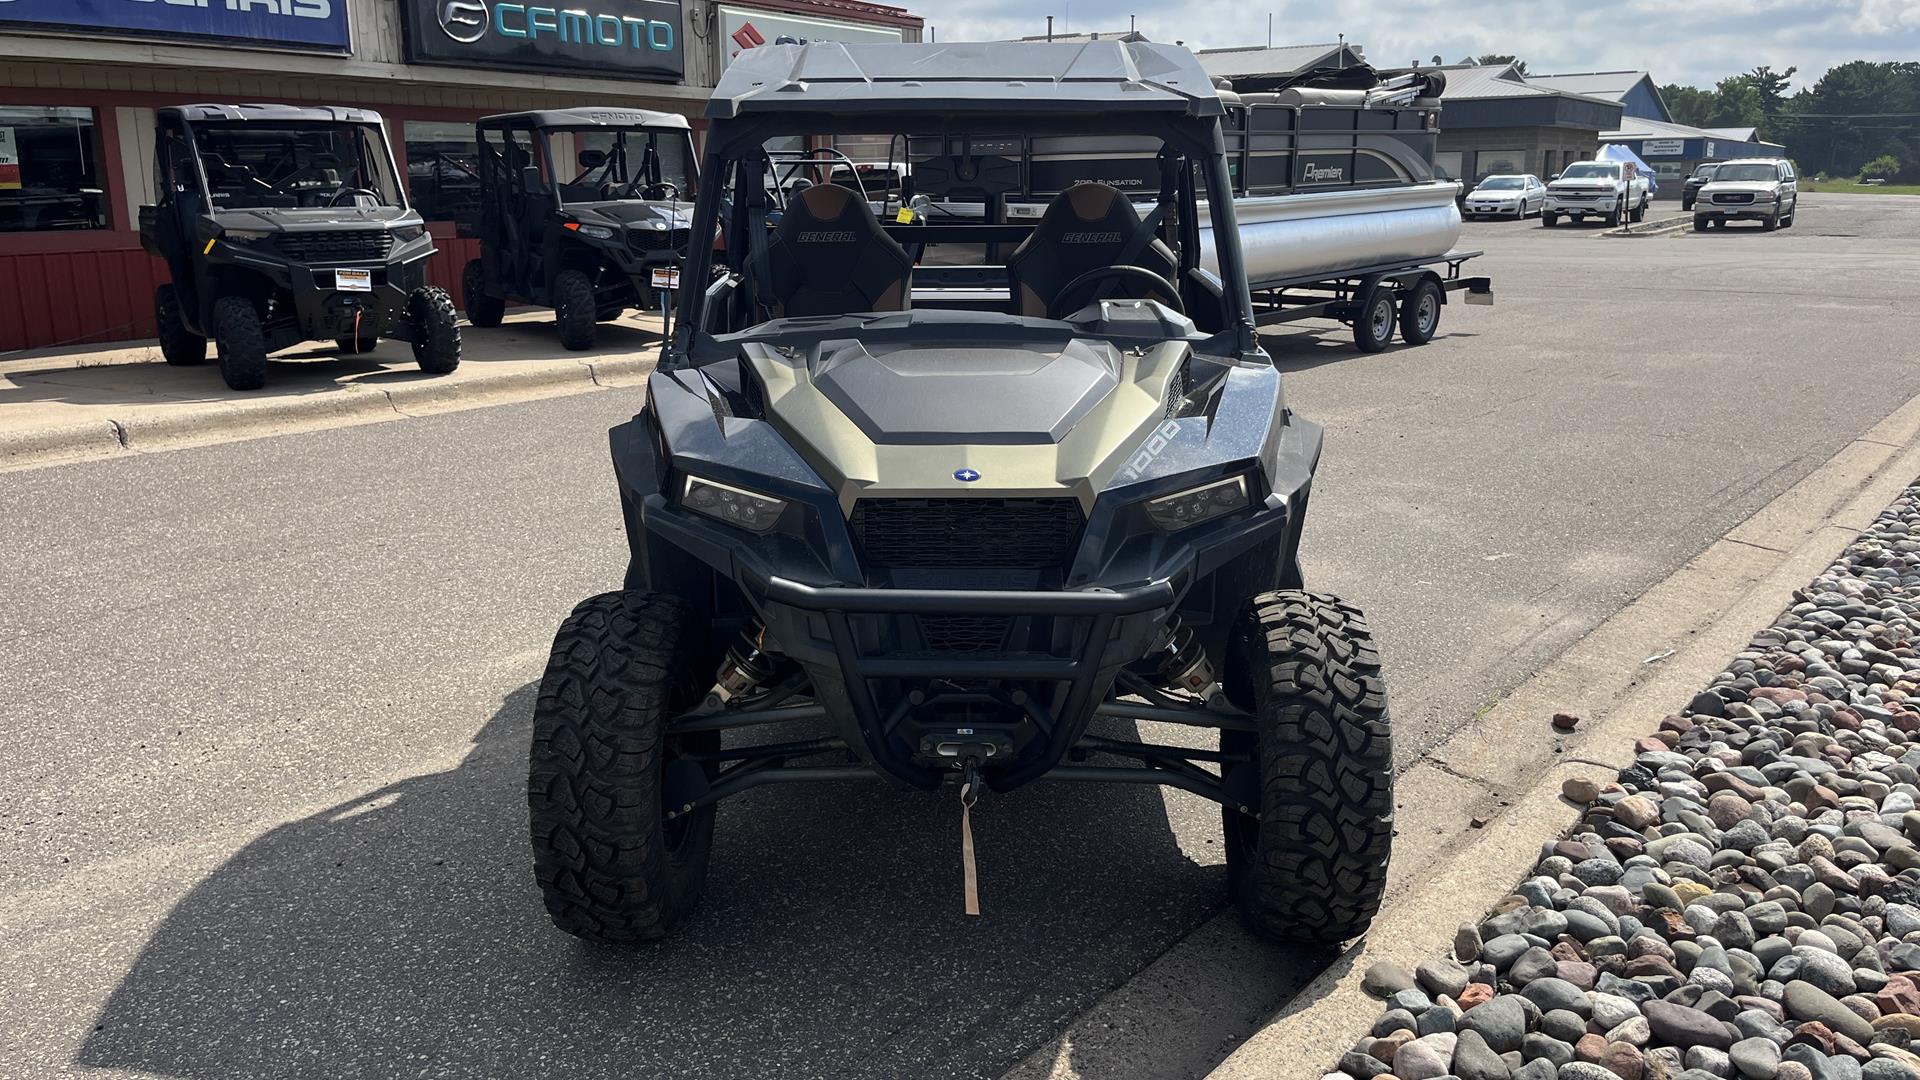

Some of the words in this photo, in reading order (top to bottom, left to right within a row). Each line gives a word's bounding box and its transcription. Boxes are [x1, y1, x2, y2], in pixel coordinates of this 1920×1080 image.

[494, 3, 674, 51] CFMOTO
[590, 111, 644, 120] CFMOTO
[797, 231, 857, 242] GENERAL
[1061, 231, 1121, 243] GENERAL
[1123, 420, 1181, 480] 1000
